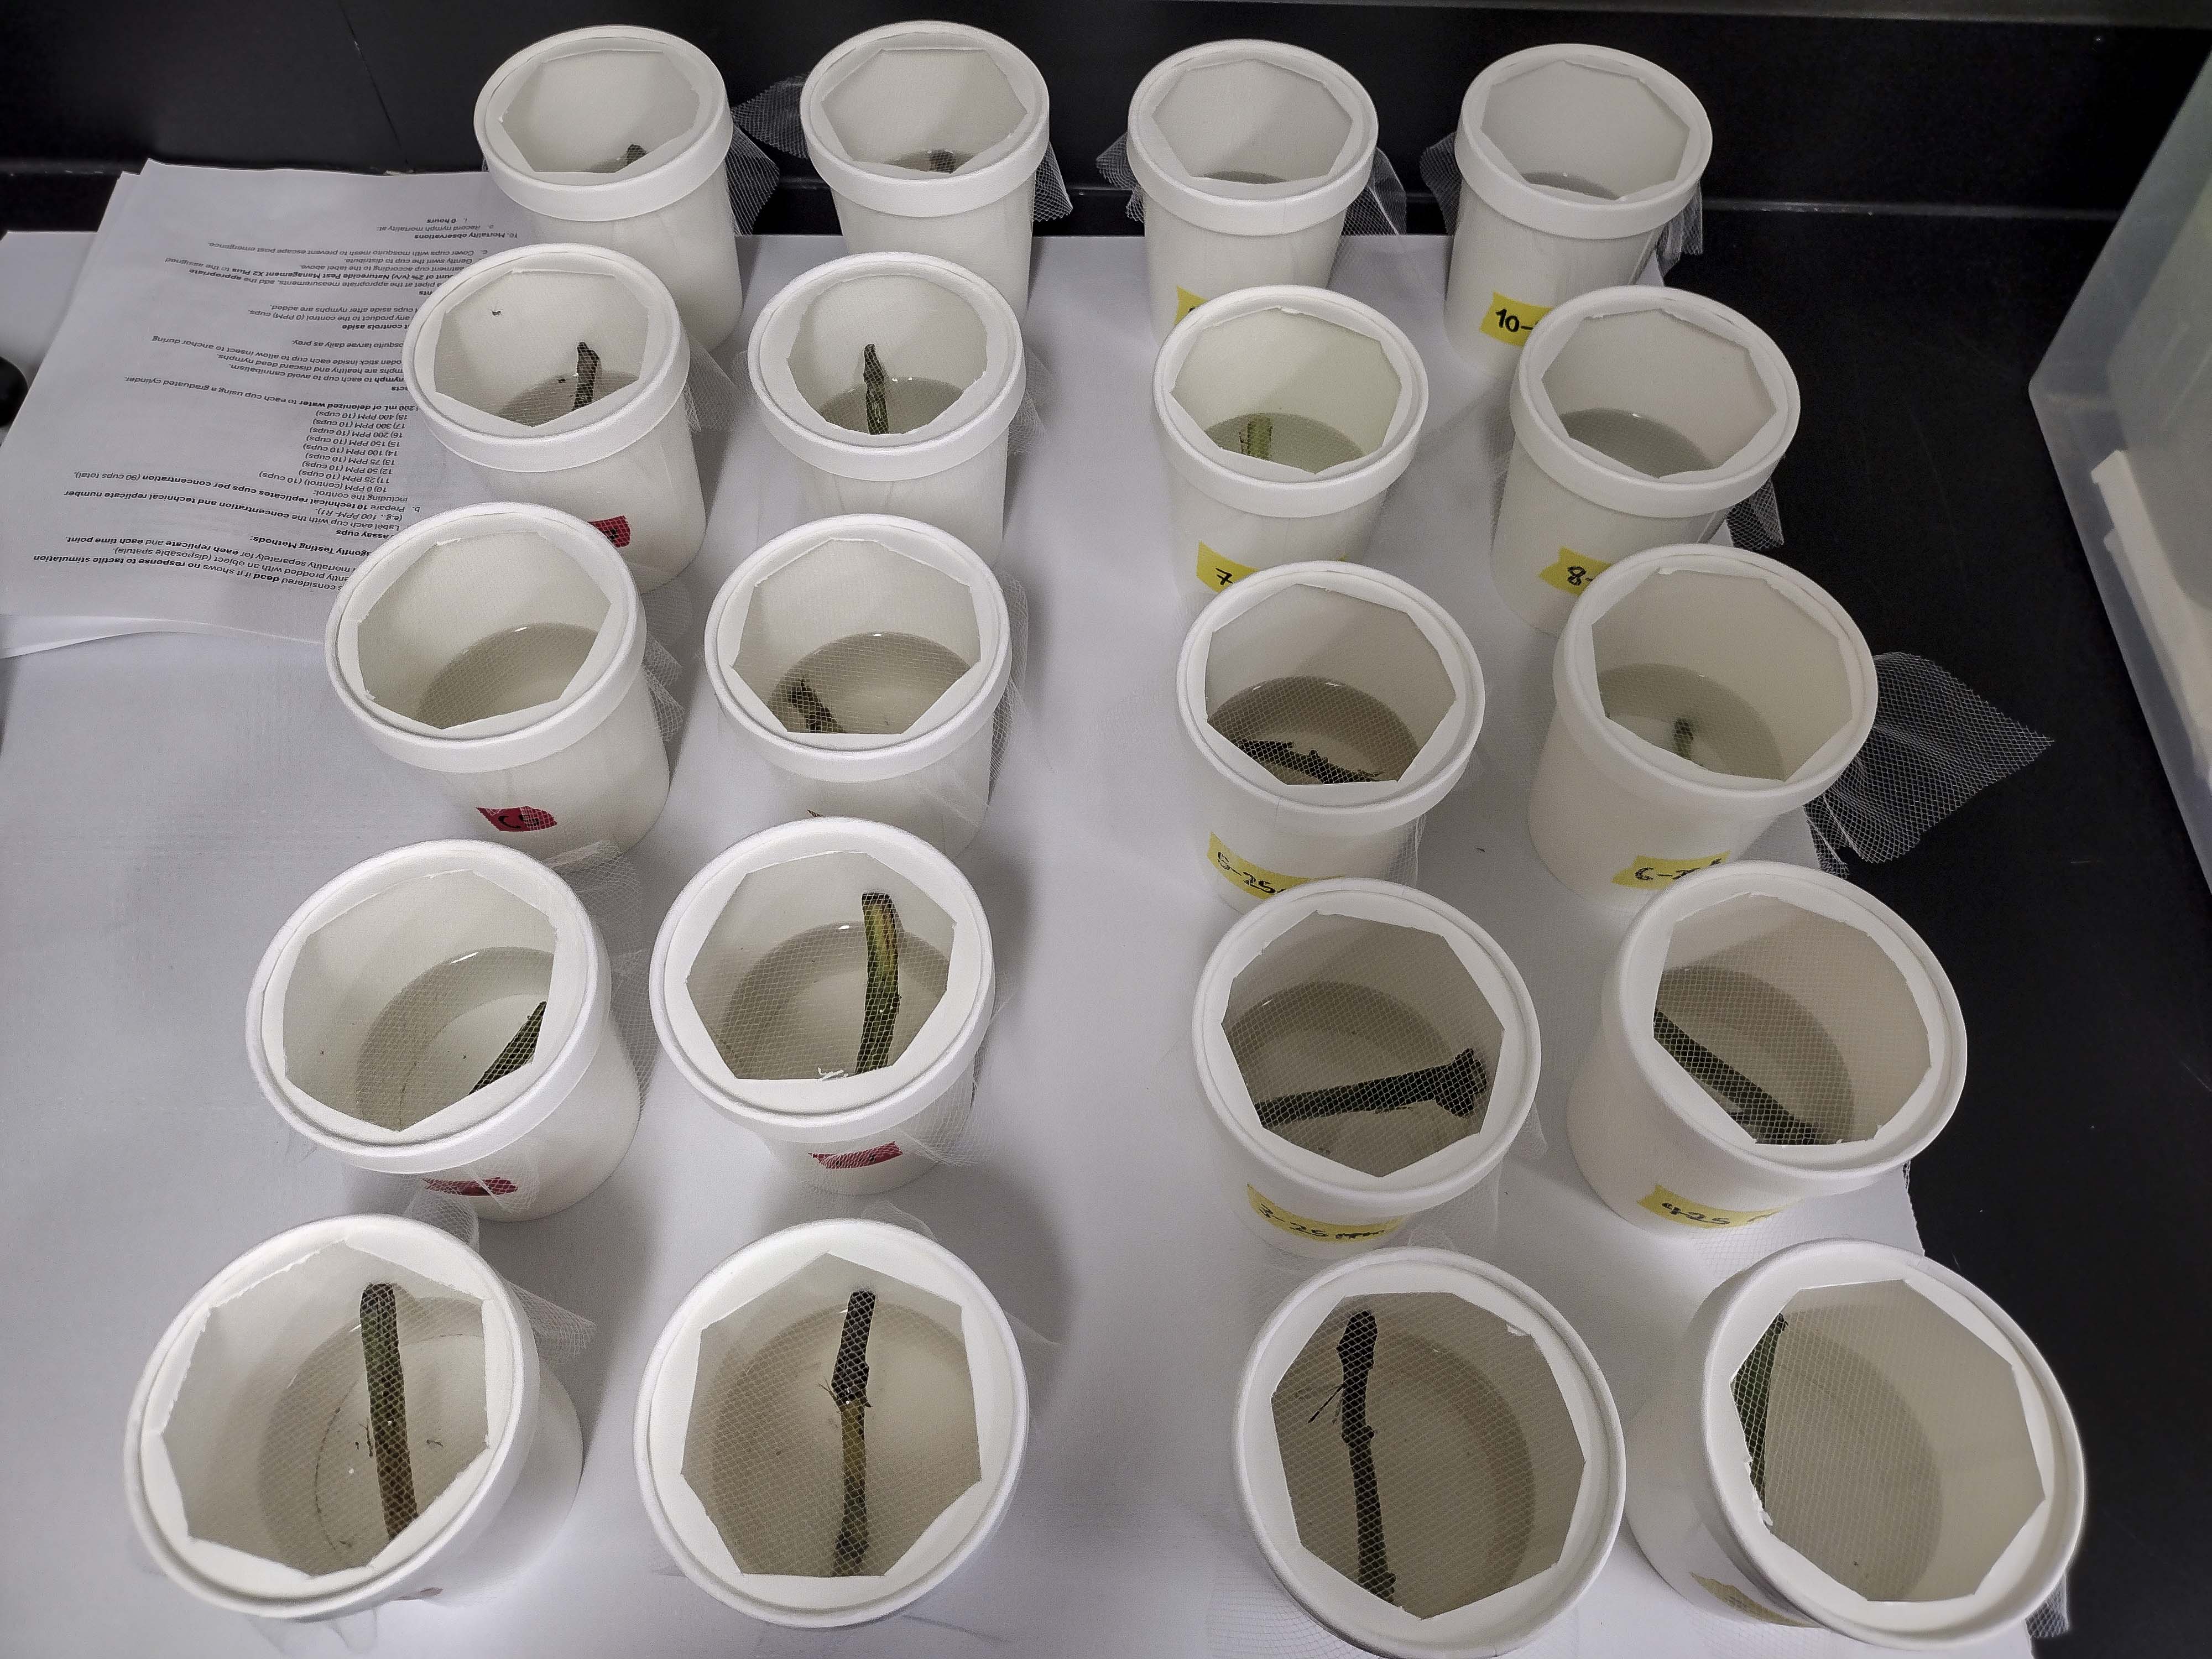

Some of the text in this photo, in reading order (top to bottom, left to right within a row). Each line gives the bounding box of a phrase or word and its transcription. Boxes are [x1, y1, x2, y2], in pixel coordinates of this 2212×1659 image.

[163, 380, 210, 390] graduated
[217, 388, 243, 396] using
[143, 476, 211, 486] concentration
[259, 471, 285, 481] cups)
[305, 479, 343, 489] (control)
[149, 494, 195, 503] technical
[259, 491, 308, 502] replicates
[310, 499, 355, 509] technical
[219, 503, 289, 518] concentration
[165, 541, 211, 550] replicate
[250, 536, 334, 554] Testing Methods:
[155, 550, 211, 561] (disposable
[255, 554, 306, 566] separately
[213, 557, 244, 566] object
[203, 565, 234, 573] shows
[307, 562, 350, 572] mortality
[253, 574, 280, 582] dead
[284, 569, 325, 578] prodded
[281, 578, 336, 589] considered
